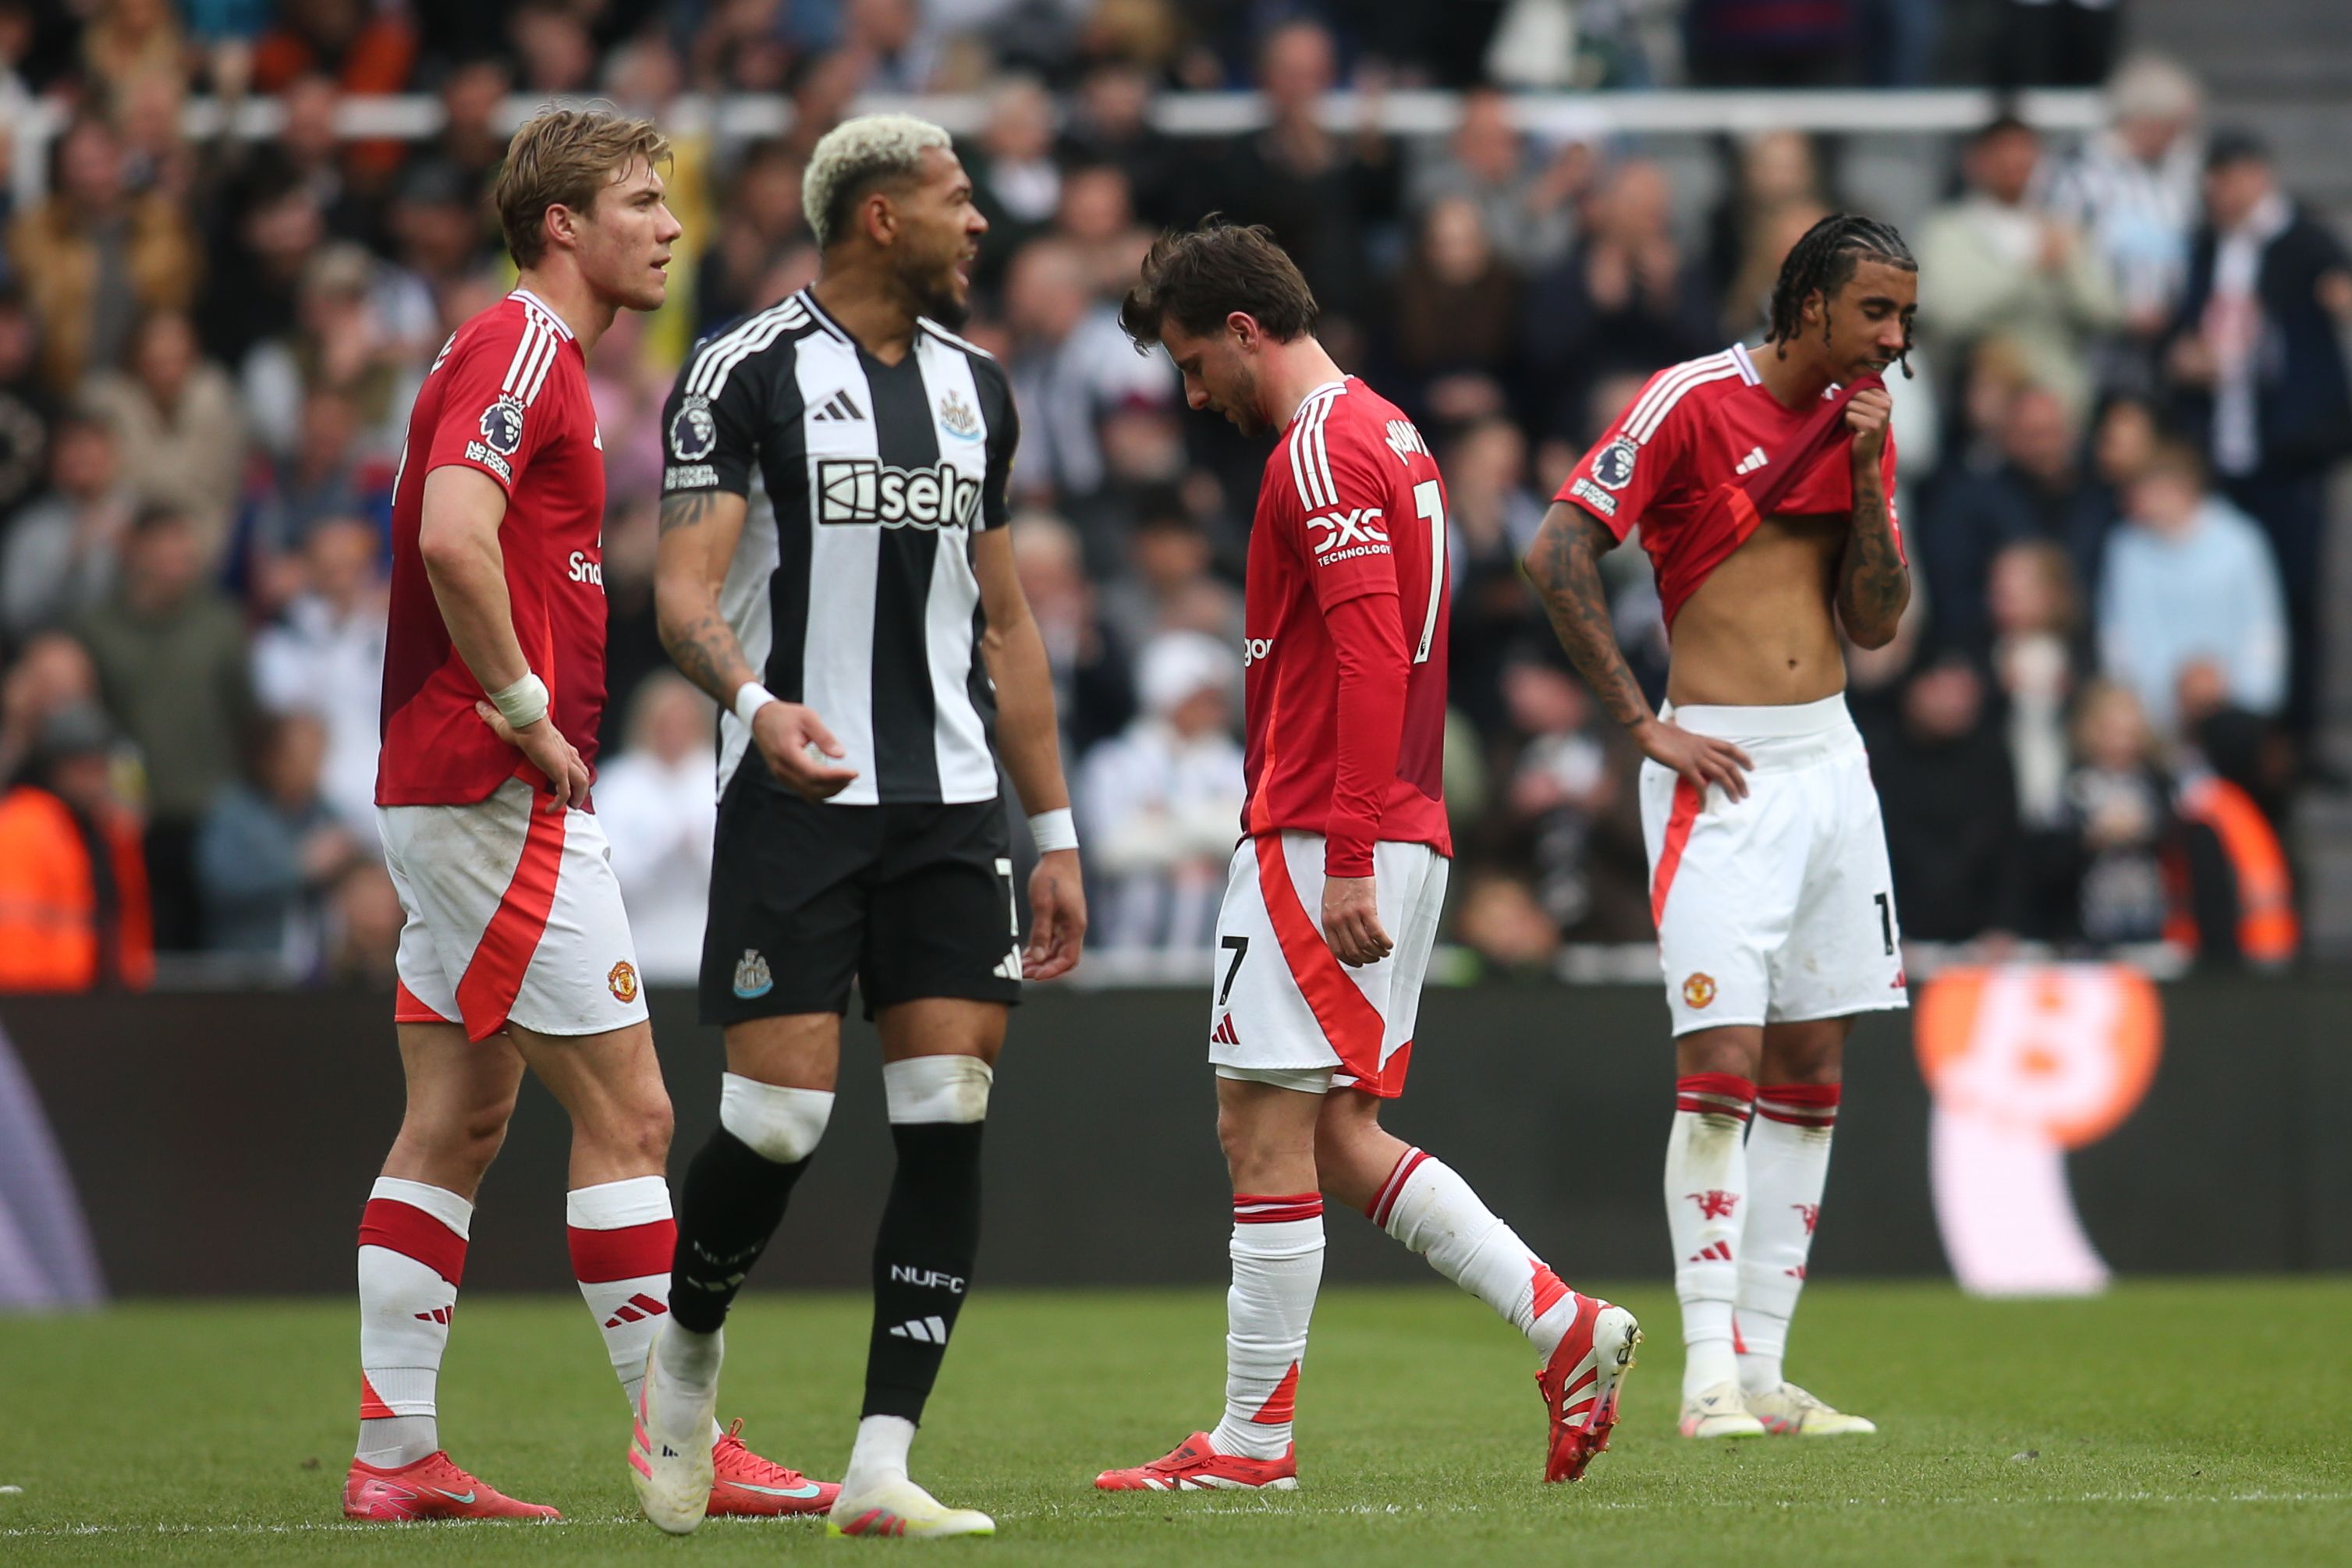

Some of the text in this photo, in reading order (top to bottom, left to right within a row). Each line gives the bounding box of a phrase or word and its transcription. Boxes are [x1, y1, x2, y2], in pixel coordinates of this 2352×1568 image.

[1306, 508, 1389, 555] DXC
[568, 551, 605, 595] Sna
[1318, 545, 1391, 567] TECHNOLOGY
[1219, 935, 1250, 1006] 7
[891, 1264, 965, 1294] NUFC
